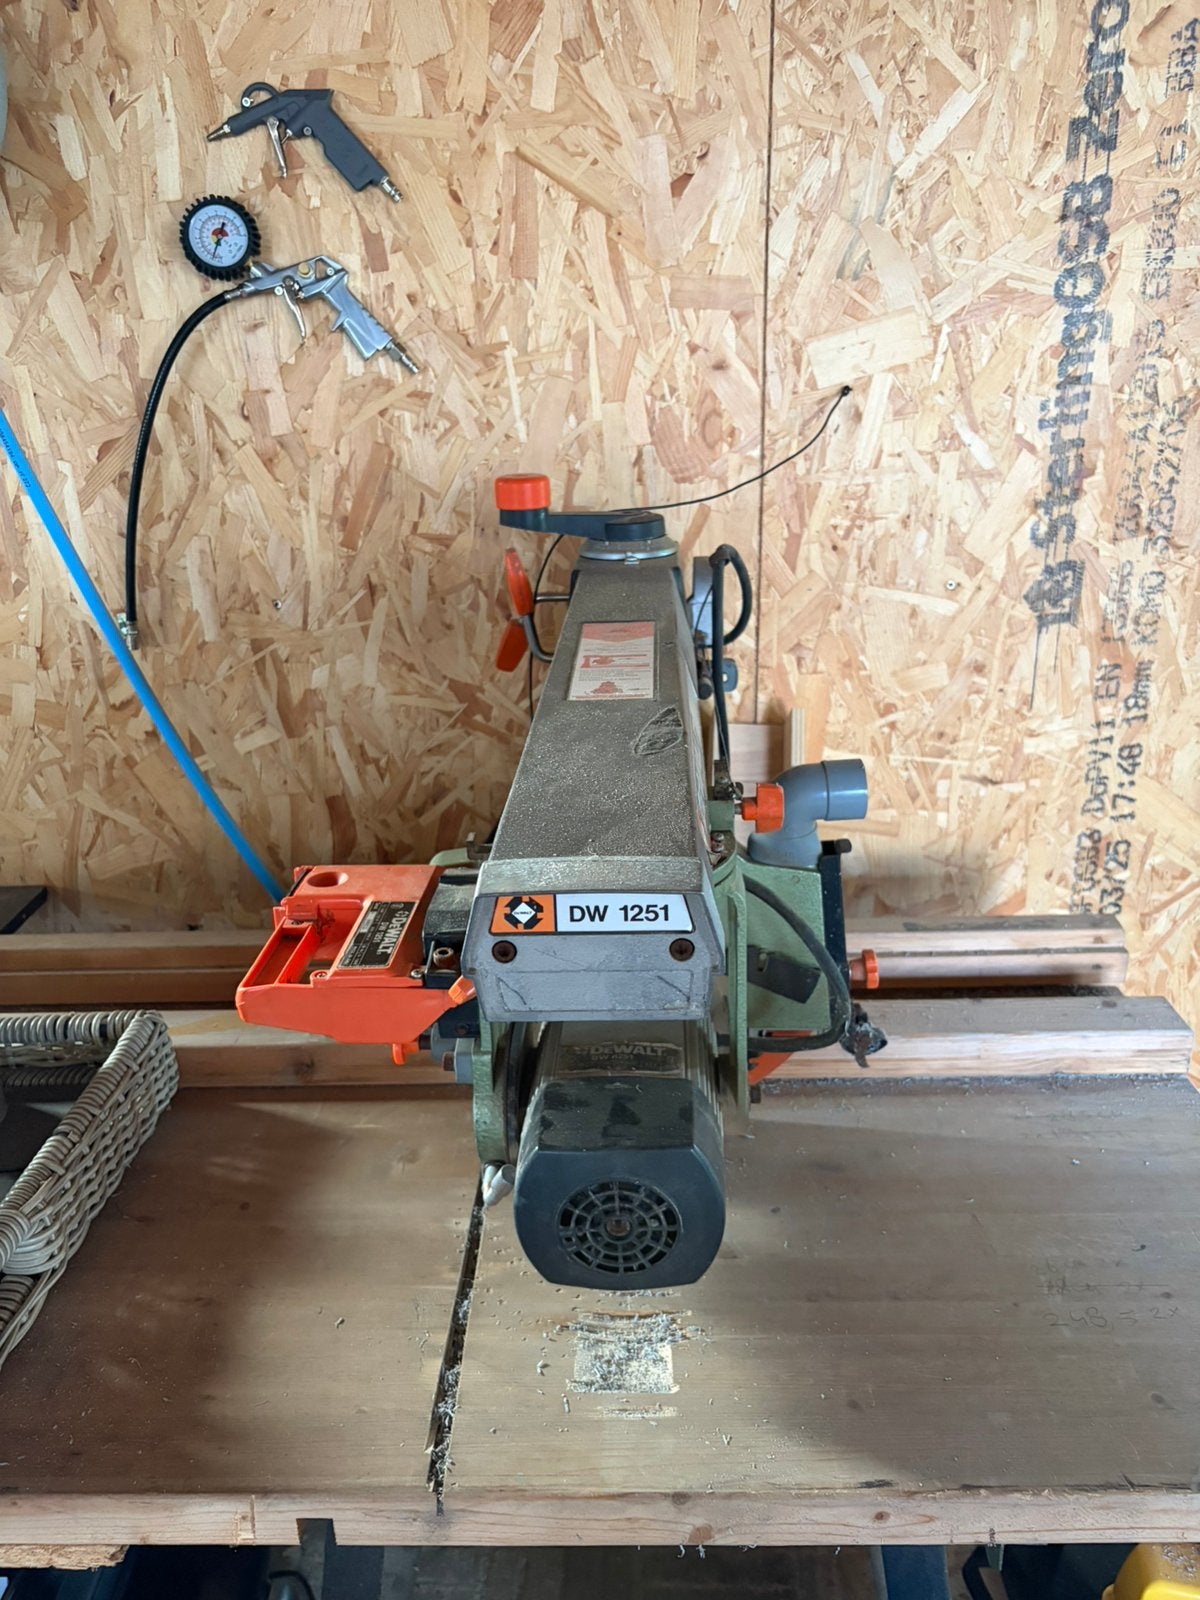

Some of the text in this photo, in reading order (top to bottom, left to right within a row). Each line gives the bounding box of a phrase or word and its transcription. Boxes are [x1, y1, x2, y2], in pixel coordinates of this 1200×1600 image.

[1066, 0, 1131, 161] Zero
[1094, 663, 1121, 701] EN
[1122, 658, 1154, 727] 18mm
[1110, 743, 1143, 823] 17:48
[569, 904, 671, 922] DW 1251
